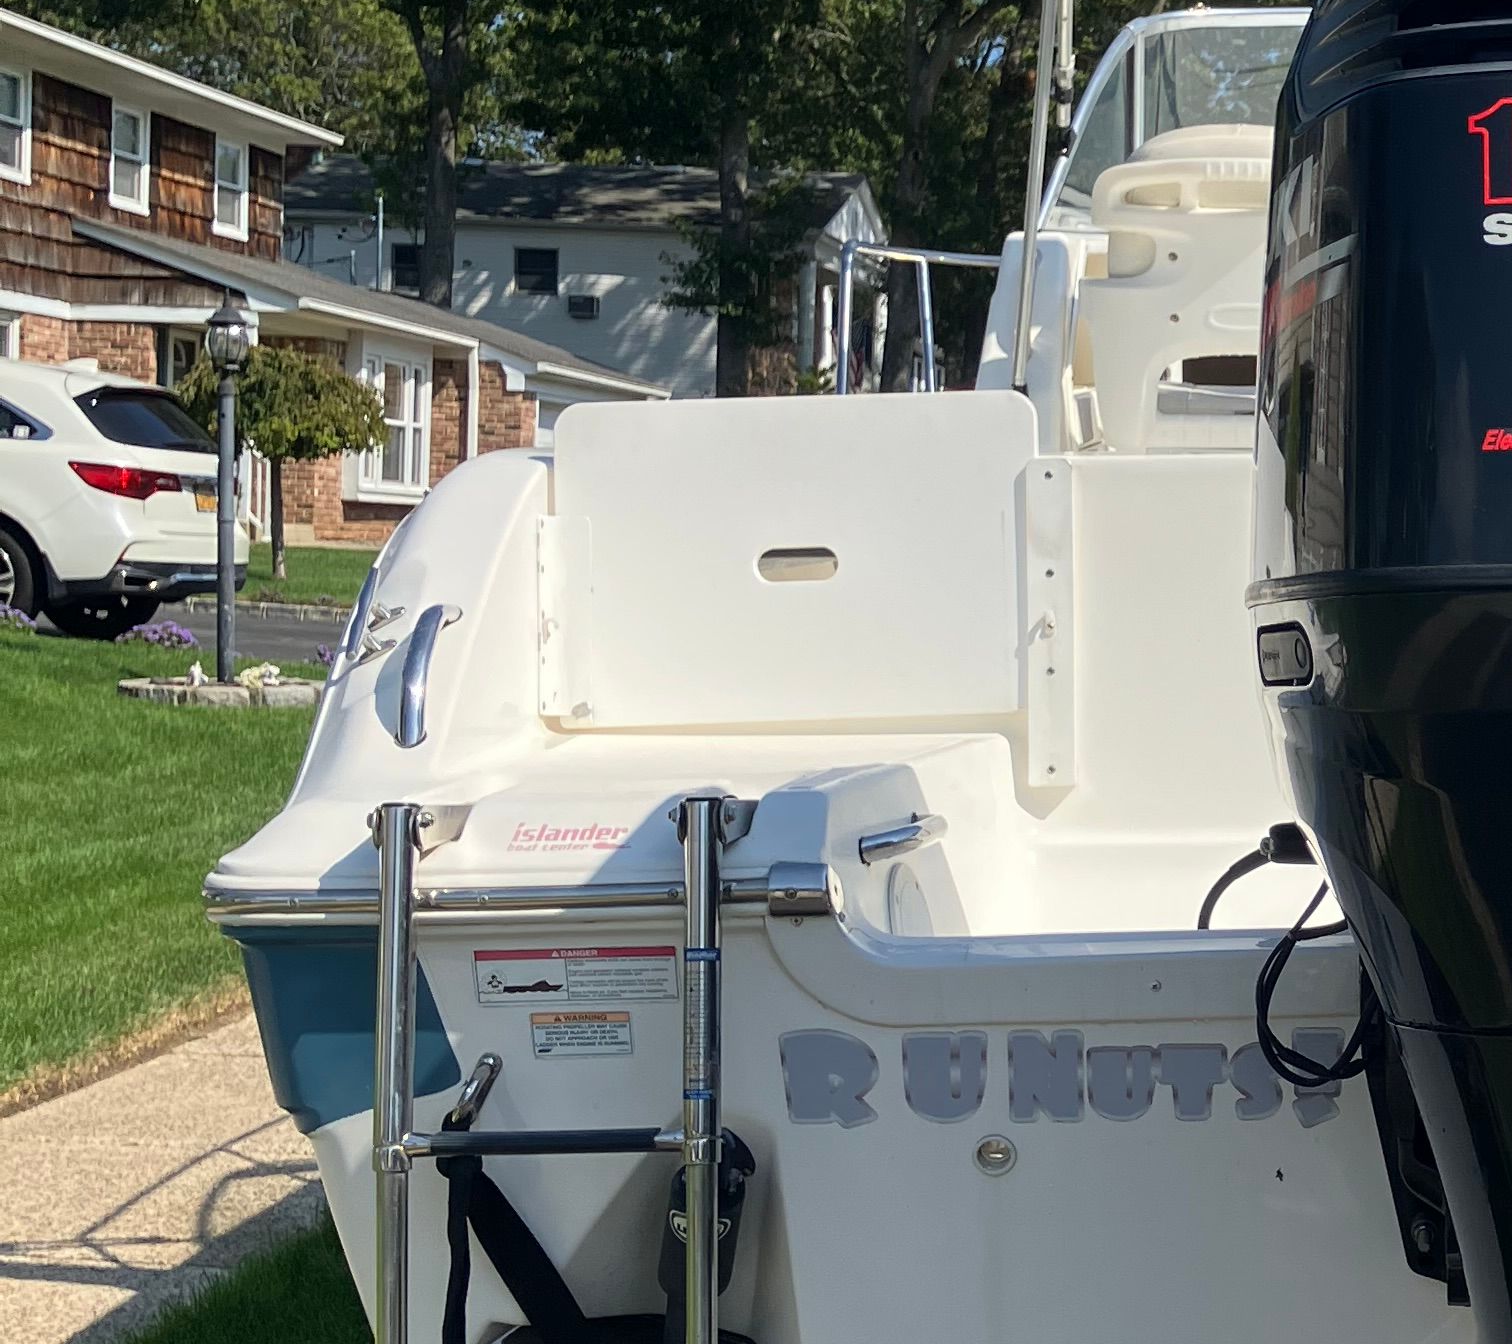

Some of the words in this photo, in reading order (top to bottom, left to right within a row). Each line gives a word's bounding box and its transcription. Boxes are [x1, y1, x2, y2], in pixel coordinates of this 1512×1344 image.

[511, 822, 629, 842] islander
[506, 843, 538, 852] boat
[541, 842, 588, 851] center
[560, 949, 599, 957] DANGER
[563, 1014, 608, 1022] WARNING
[778, 1028, 880, 1129] R
[902, 1029, 988, 1124] U
